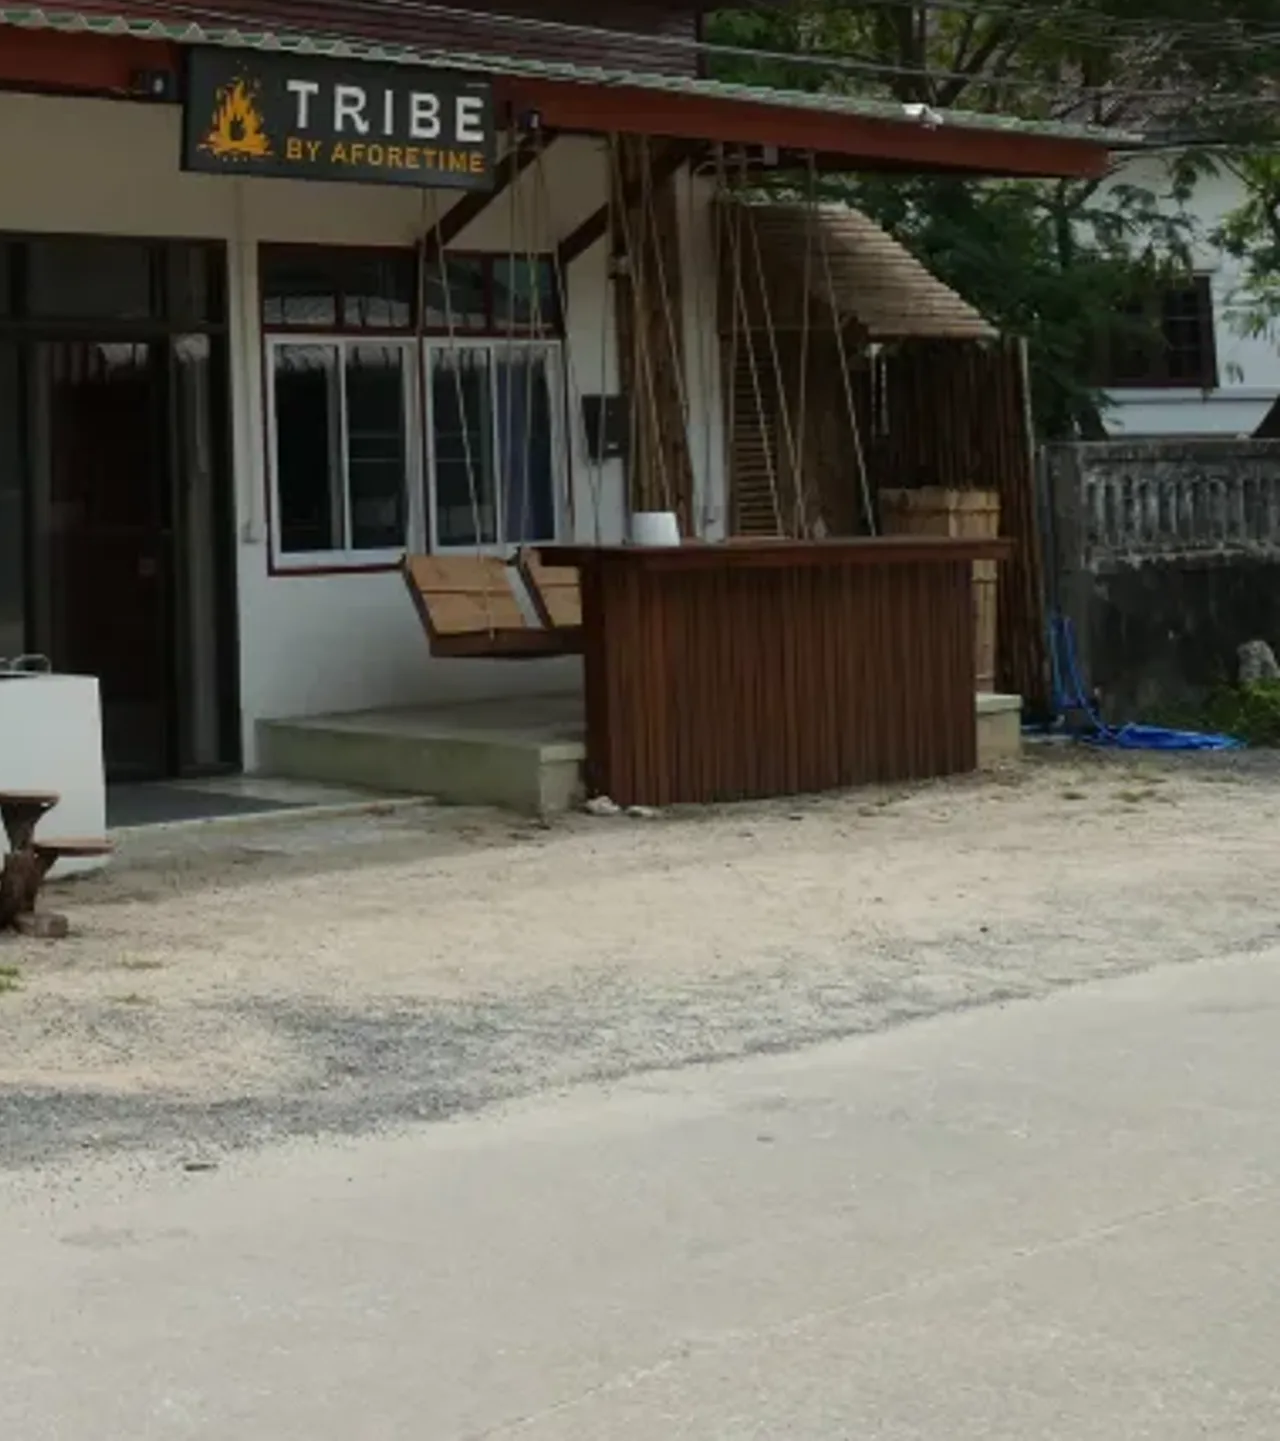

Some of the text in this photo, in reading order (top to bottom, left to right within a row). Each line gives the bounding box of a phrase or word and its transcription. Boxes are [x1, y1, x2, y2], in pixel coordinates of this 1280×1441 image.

[286, 79, 485, 143] TRIBE
[286, 137, 486, 174] BY AFORETIME
